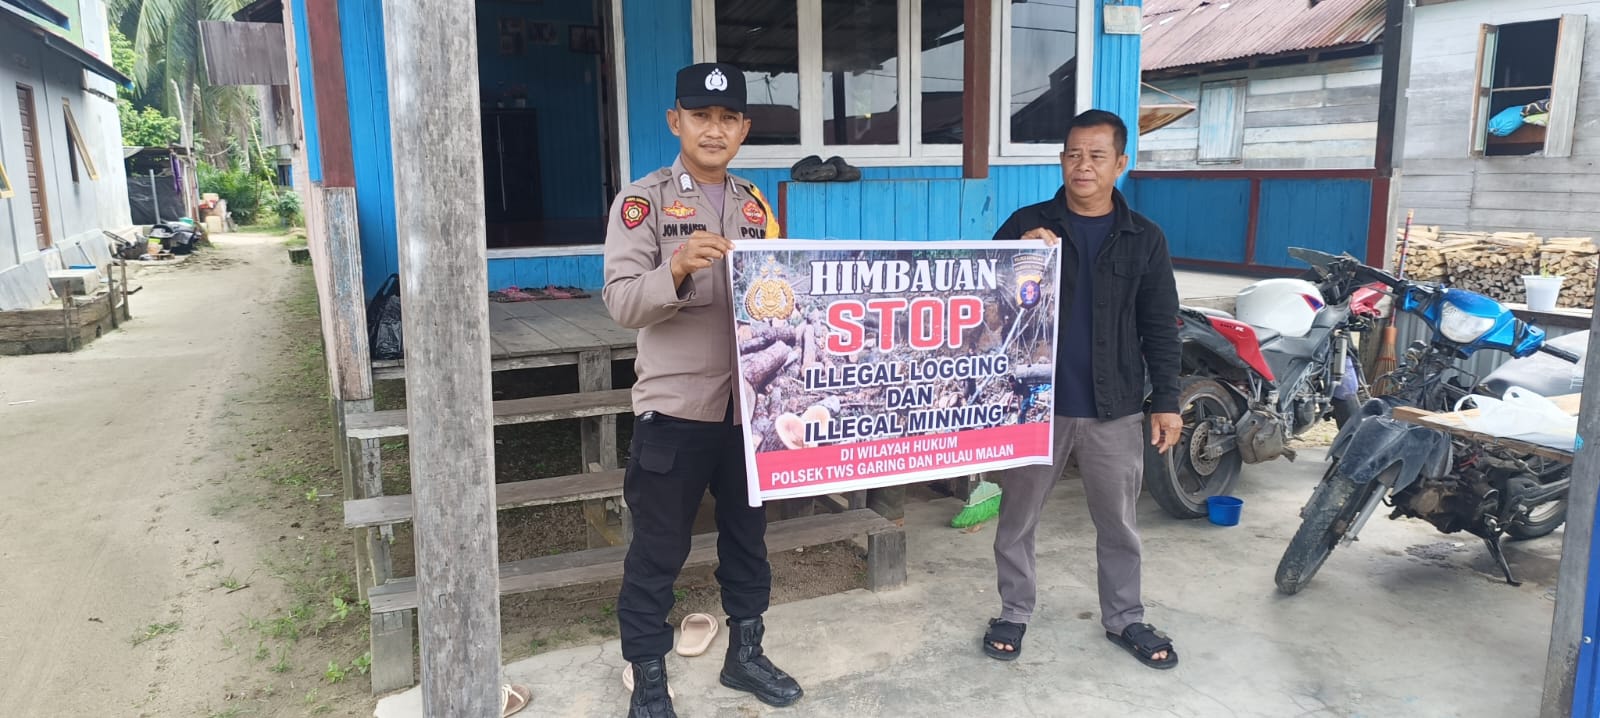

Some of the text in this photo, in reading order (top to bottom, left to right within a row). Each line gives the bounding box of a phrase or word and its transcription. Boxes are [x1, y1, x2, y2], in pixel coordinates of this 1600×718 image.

[662, 223, 678, 237] JON
[810, 259, 997, 295] HIMBAUAN
[827, 297, 983, 354] STOP
[805, 356, 1007, 389] ILLEGAL LOGGING
[887, 386, 933, 409] DAN
[805, 405, 1002, 442] ILLEGAL MINNING
[771, 444, 1014, 486] POLSEK TWS GARING DAN PULAU MALAN
[840, 437, 958, 461] DI WILAYAH HUKUM
